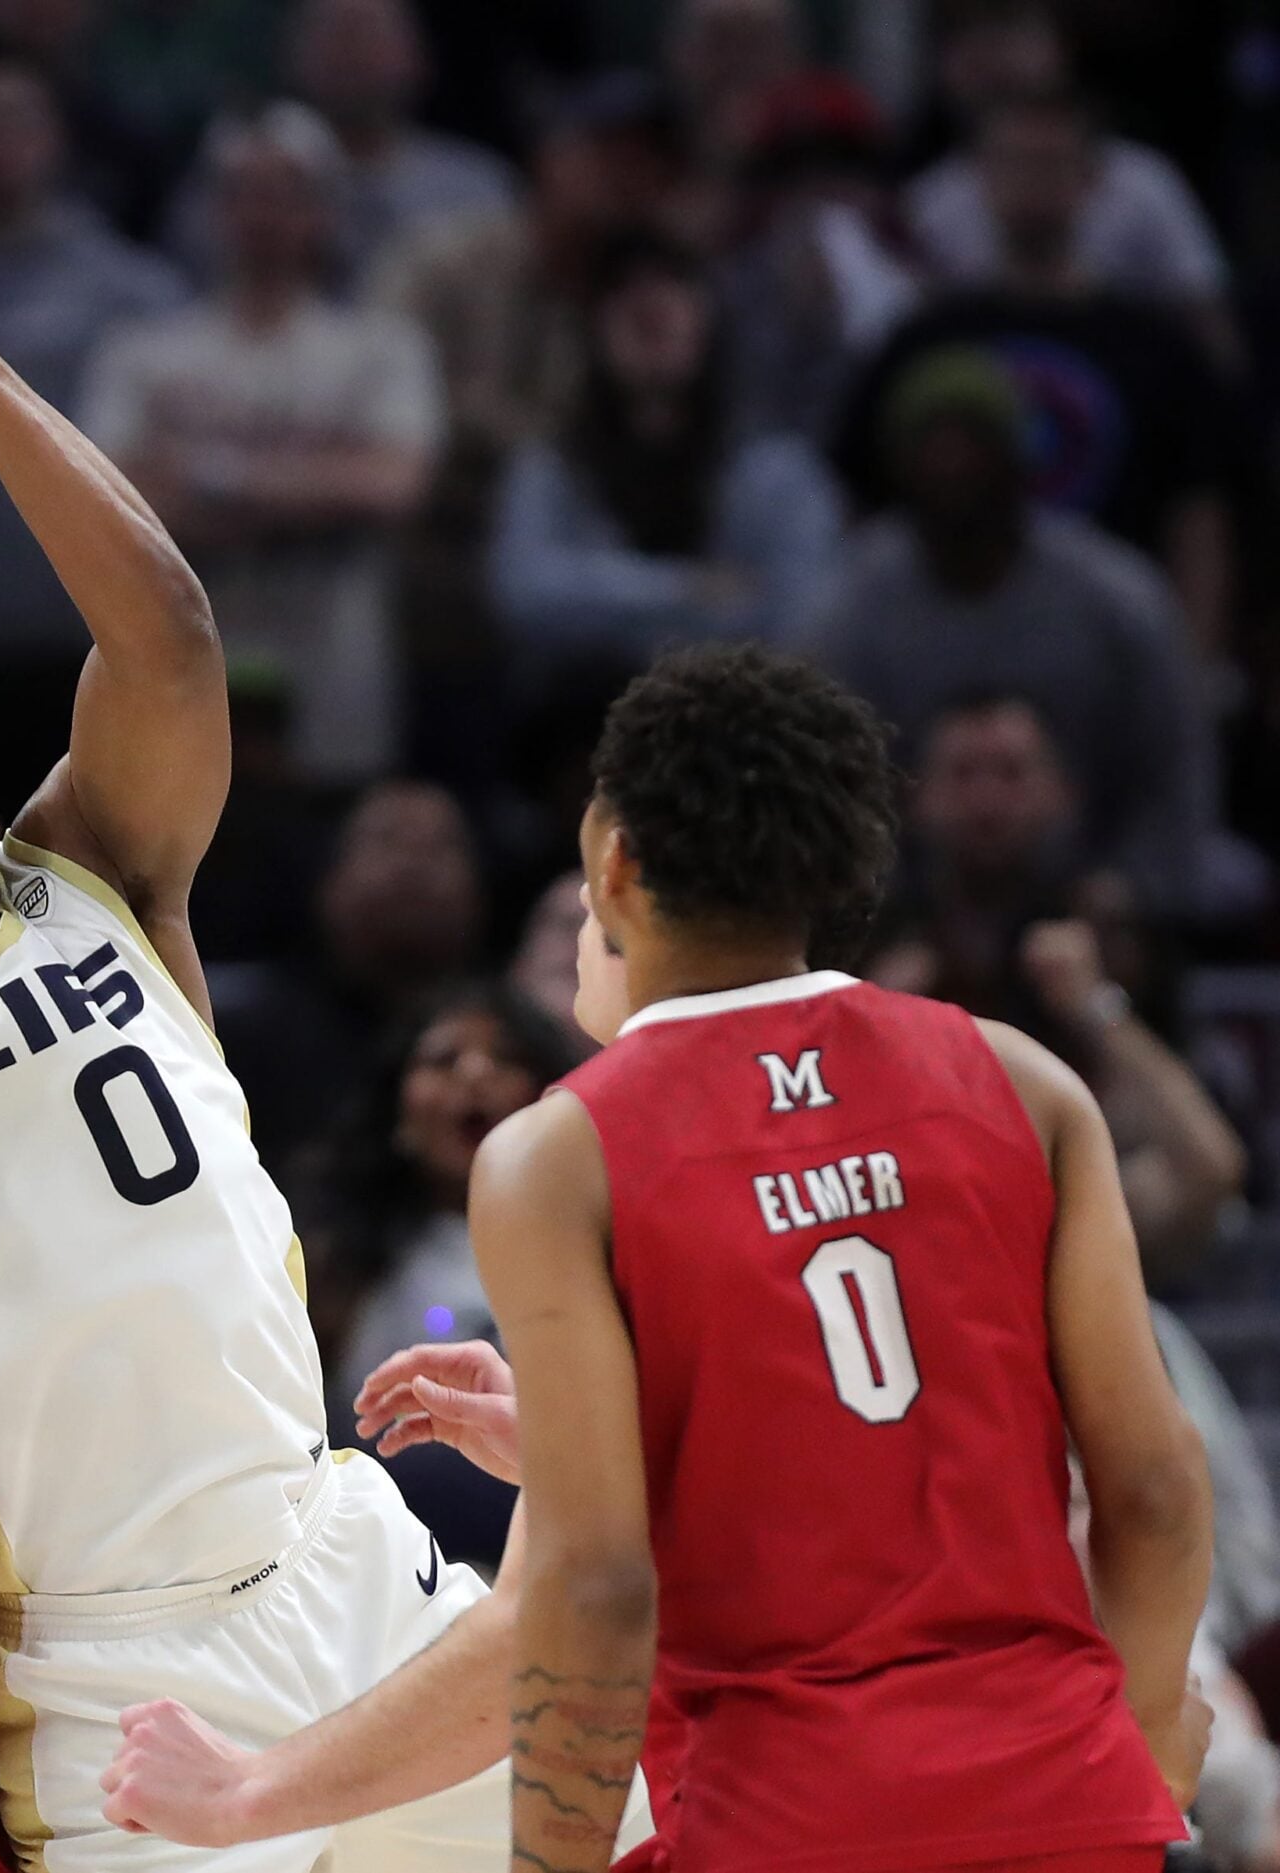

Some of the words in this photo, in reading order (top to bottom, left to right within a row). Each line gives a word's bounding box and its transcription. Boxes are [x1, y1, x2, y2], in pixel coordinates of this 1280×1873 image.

[755, 1047, 838, 1112] M
[73, 1045, 200, 1205] 0
[752, 1150, 906, 1235] ELMER
[800, 1234, 922, 1425] 0
[230, 1560, 279, 1594] AKRON
